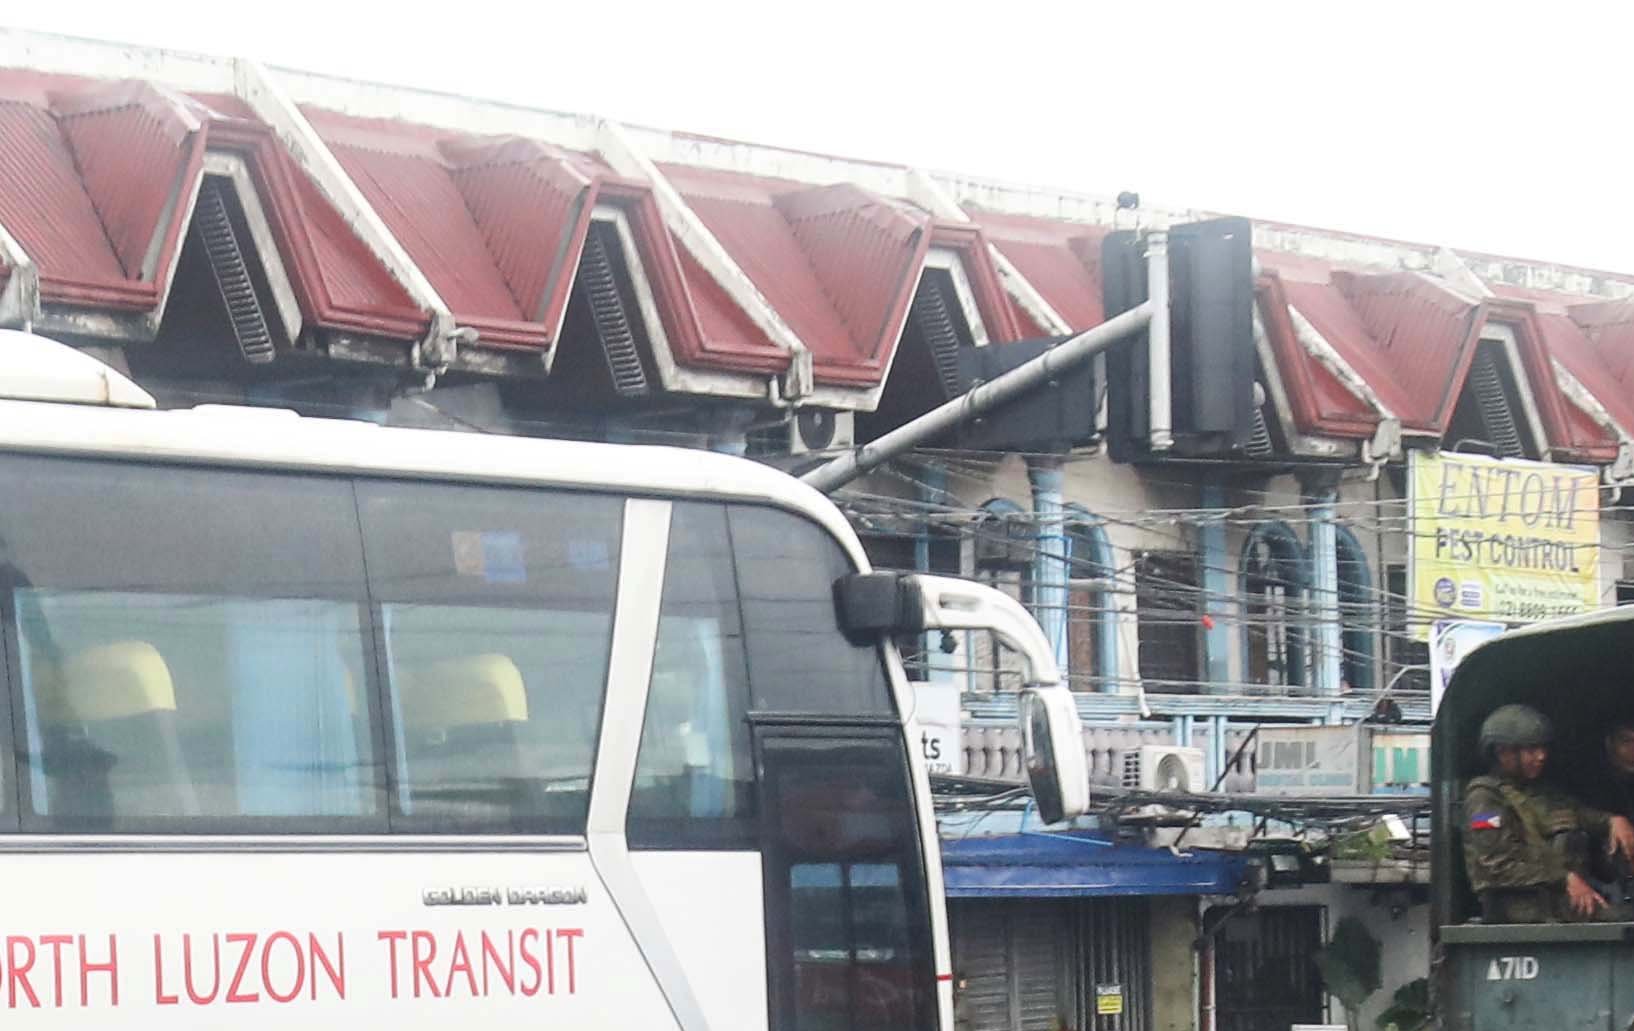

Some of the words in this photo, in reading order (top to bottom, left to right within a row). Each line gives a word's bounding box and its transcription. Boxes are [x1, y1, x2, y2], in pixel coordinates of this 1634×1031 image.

[1438, 462, 1582, 533] ENTOM
[1435, 526, 1484, 563] PEST
[1491, 534, 1580, 573] CONTROL
[0, 933, 119, 1008] RTH
[153, 930, 346, 1005] LUZON
[377, 927, 585, 999] TRANSIT
